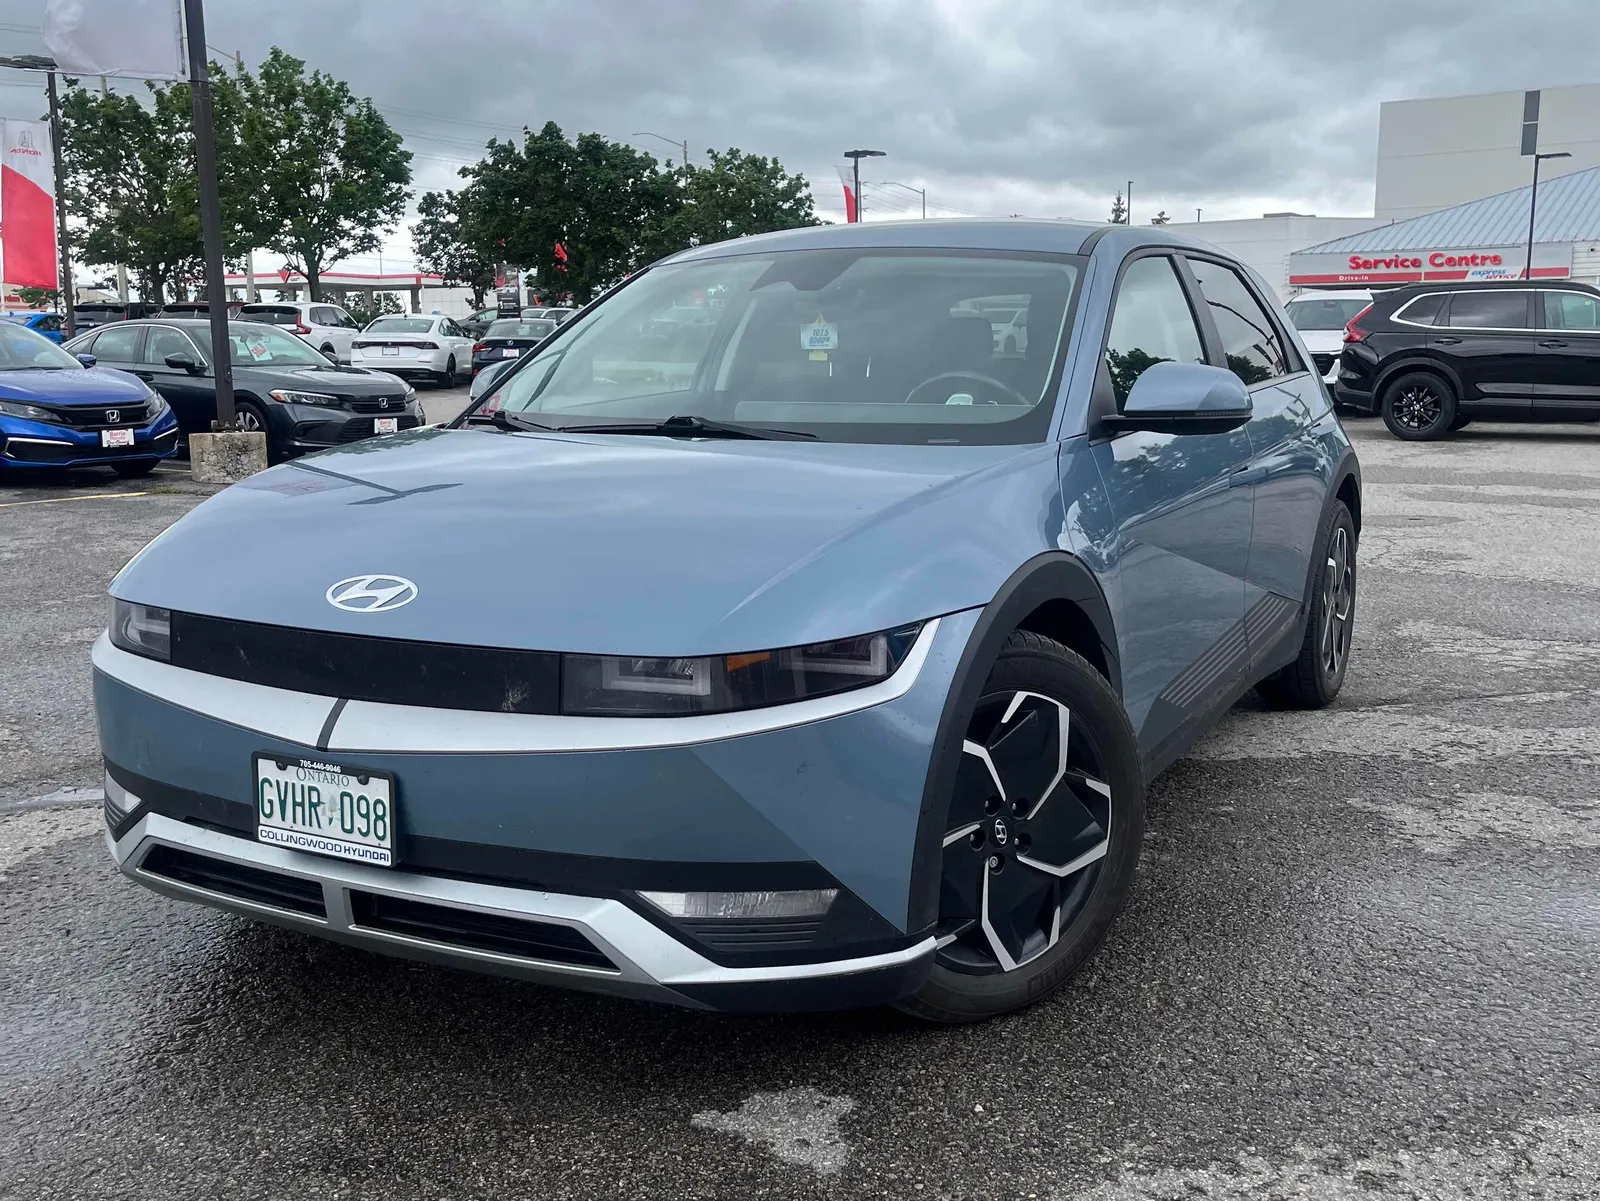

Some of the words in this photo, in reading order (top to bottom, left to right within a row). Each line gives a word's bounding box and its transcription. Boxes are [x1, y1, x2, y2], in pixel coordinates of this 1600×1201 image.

[1348, 254, 1422, 271] Service
[1428, 252, 1503, 268] Centre
[1471, 268, 1507, 277] express
[300, 759, 342, 774] 705-446-9046
[296, 767, 350, 787] ONTARIO
[260, 777, 323, 829] GVHR
[340, 791, 387, 841] 098
[260, 829, 342, 853] COLLINGWOOD
[343, 846, 390, 862] HYUNDAI
